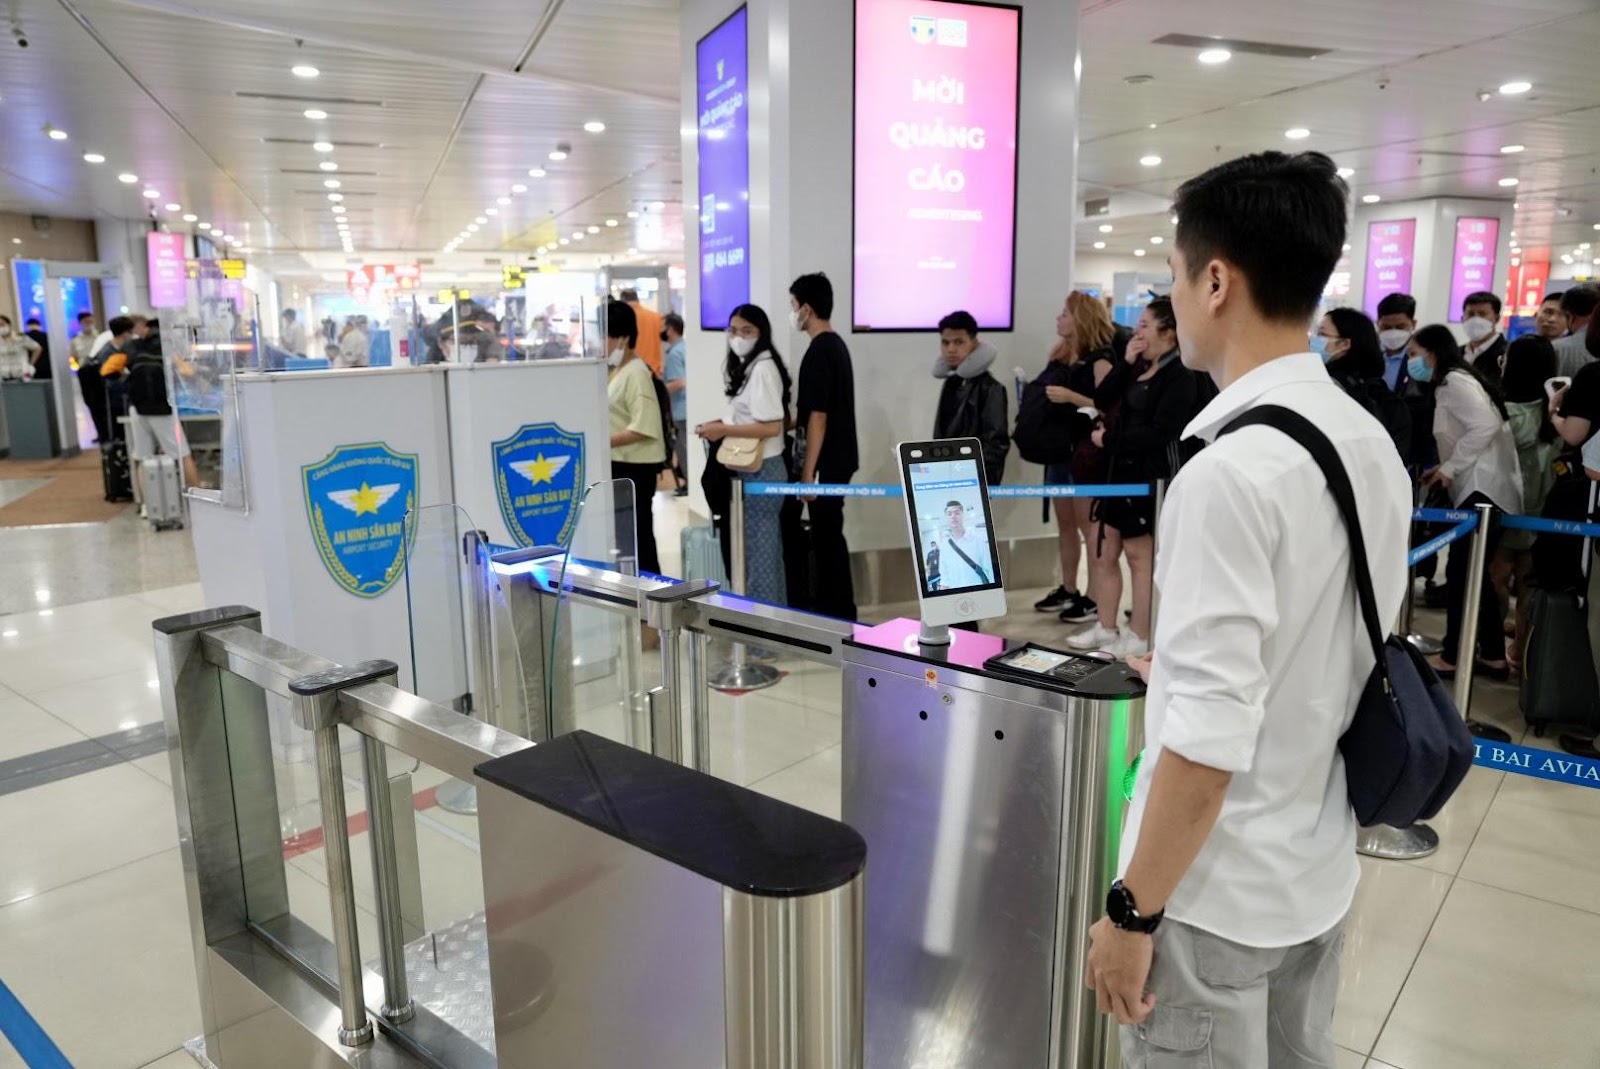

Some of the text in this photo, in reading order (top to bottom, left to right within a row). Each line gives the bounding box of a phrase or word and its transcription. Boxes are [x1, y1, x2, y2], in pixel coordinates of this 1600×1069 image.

[911, 74, 965, 105] MỜI
[889, 116, 985, 150] QUẢNG
[907, 162, 966, 193] CÁO
[515, 496, 525, 508] AN
[525, 493, 543, 507] NINH
[558, 488, 572, 501] BAY
[764, 486, 777, 494] AN
[799, 486, 824, 495] HÀNG
[825, 486, 855, 496] KHÔNG
[855, 487, 870, 497] NỘI
[871, 486, 886, 496] BÀI
[990, 486, 1076, 496] HÀNG KHÔNG NỘI BÀI
[334, 521, 401, 545] AN NINH SÂN BAY
[343, 540, 393, 555] AIRPORT SECURITY
[1491, 747, 1532, 768] BAI
[1539, 757, 1600, 781] AVIA
